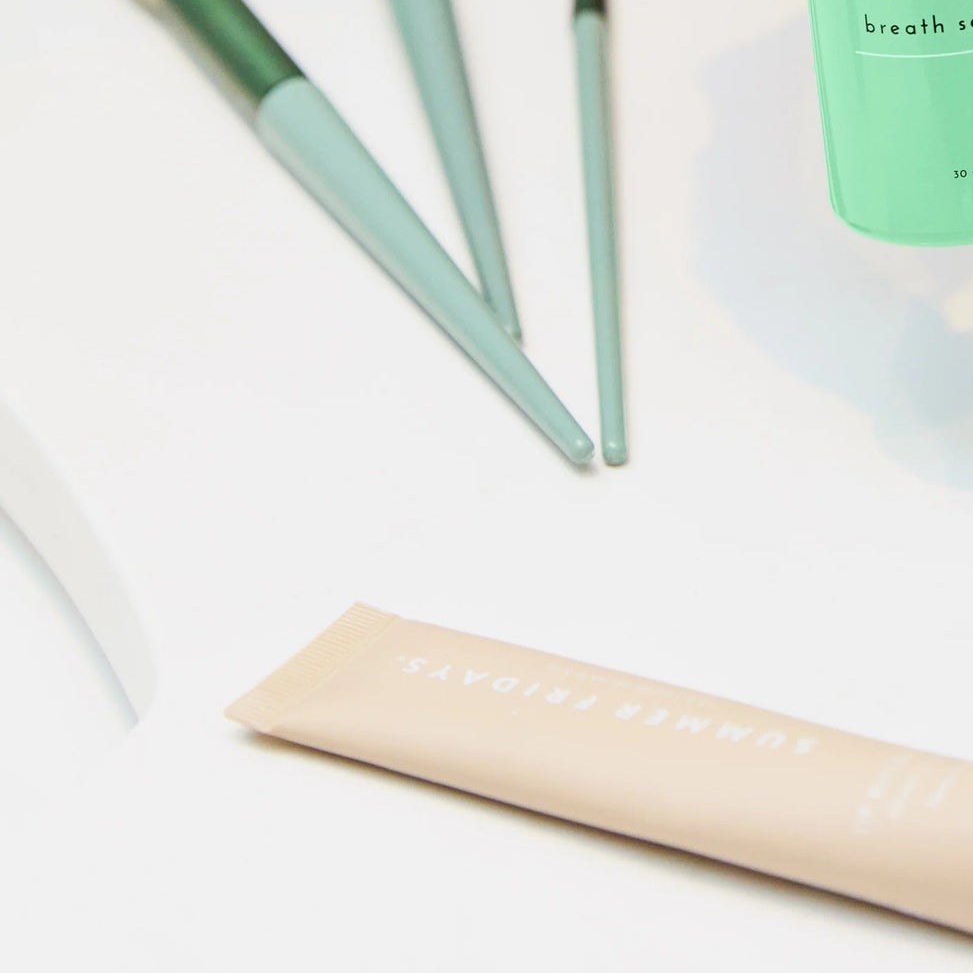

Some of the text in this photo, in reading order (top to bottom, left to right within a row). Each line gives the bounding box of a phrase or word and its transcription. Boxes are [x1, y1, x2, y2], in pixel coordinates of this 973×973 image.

[864, 14, 945, 35] breath
[953, 169, 967, 179] 30
[401, 657, 599, 712] FRIDAYS
[614, 701, 820, 756] SUMMER
